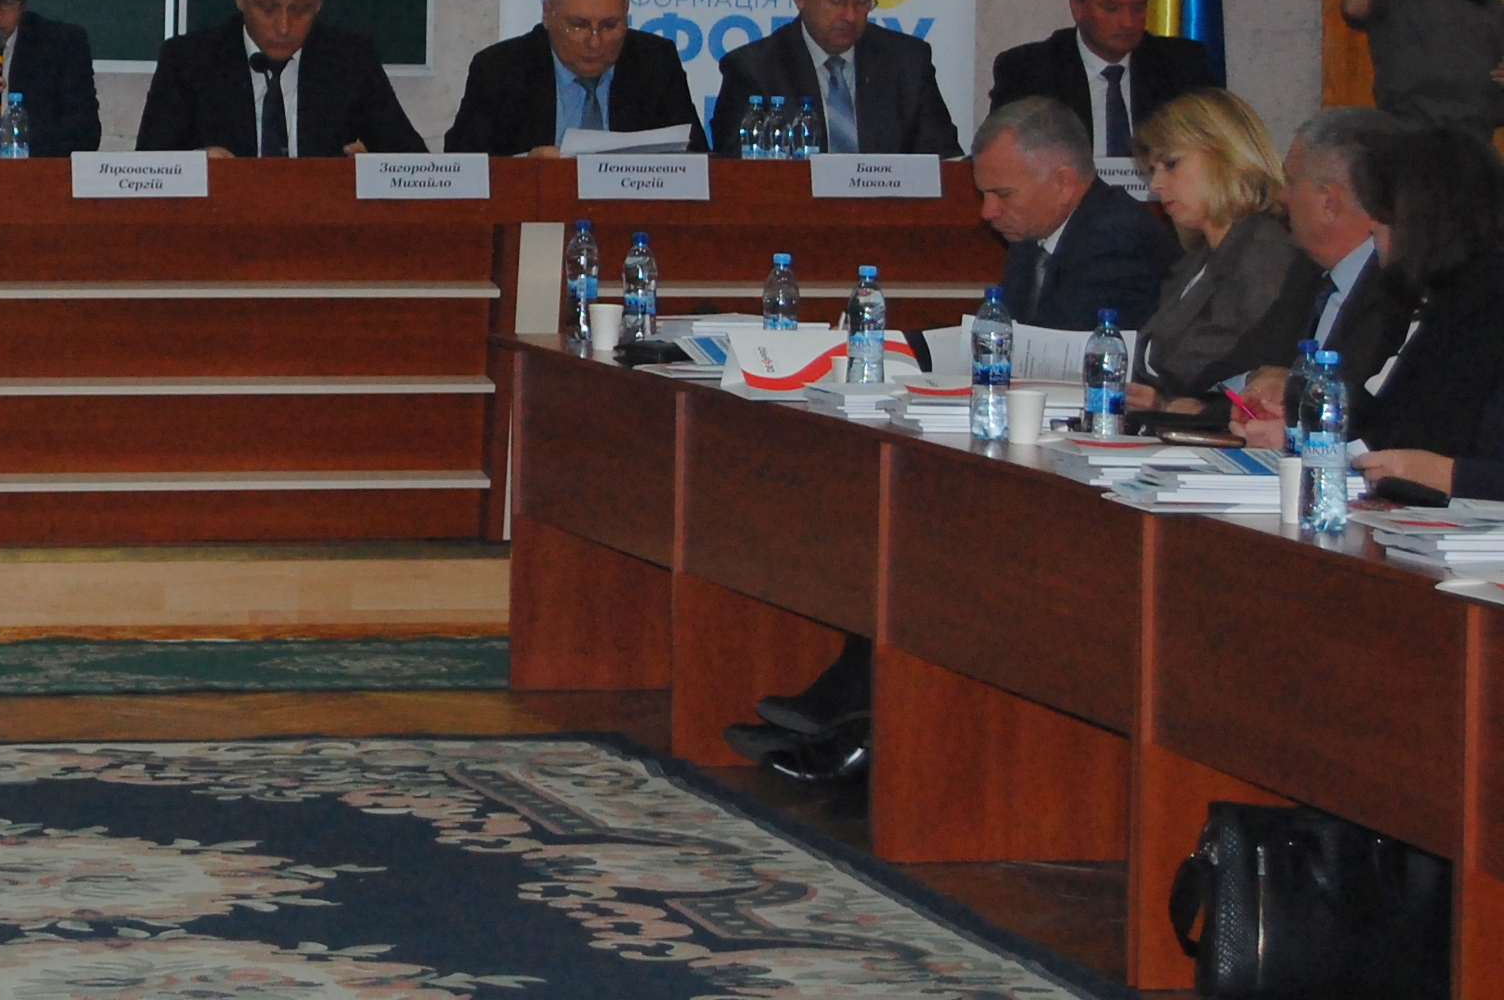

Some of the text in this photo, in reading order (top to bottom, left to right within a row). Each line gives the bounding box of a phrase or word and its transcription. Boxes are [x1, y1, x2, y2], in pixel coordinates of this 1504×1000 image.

[99, 162, 182, 176] Яцковський
[379, 161, 461, 175] Загородний
[597, 162, 687, 174] Пенюшкевич
[856, 162, 893, 173] Баюк
[118, 178, 164, 192] Сергій
[389, 177, 453, 188] Михайло
[620, 177, 664, 191] Сергій
[848, 177, 902, 188] Микола
